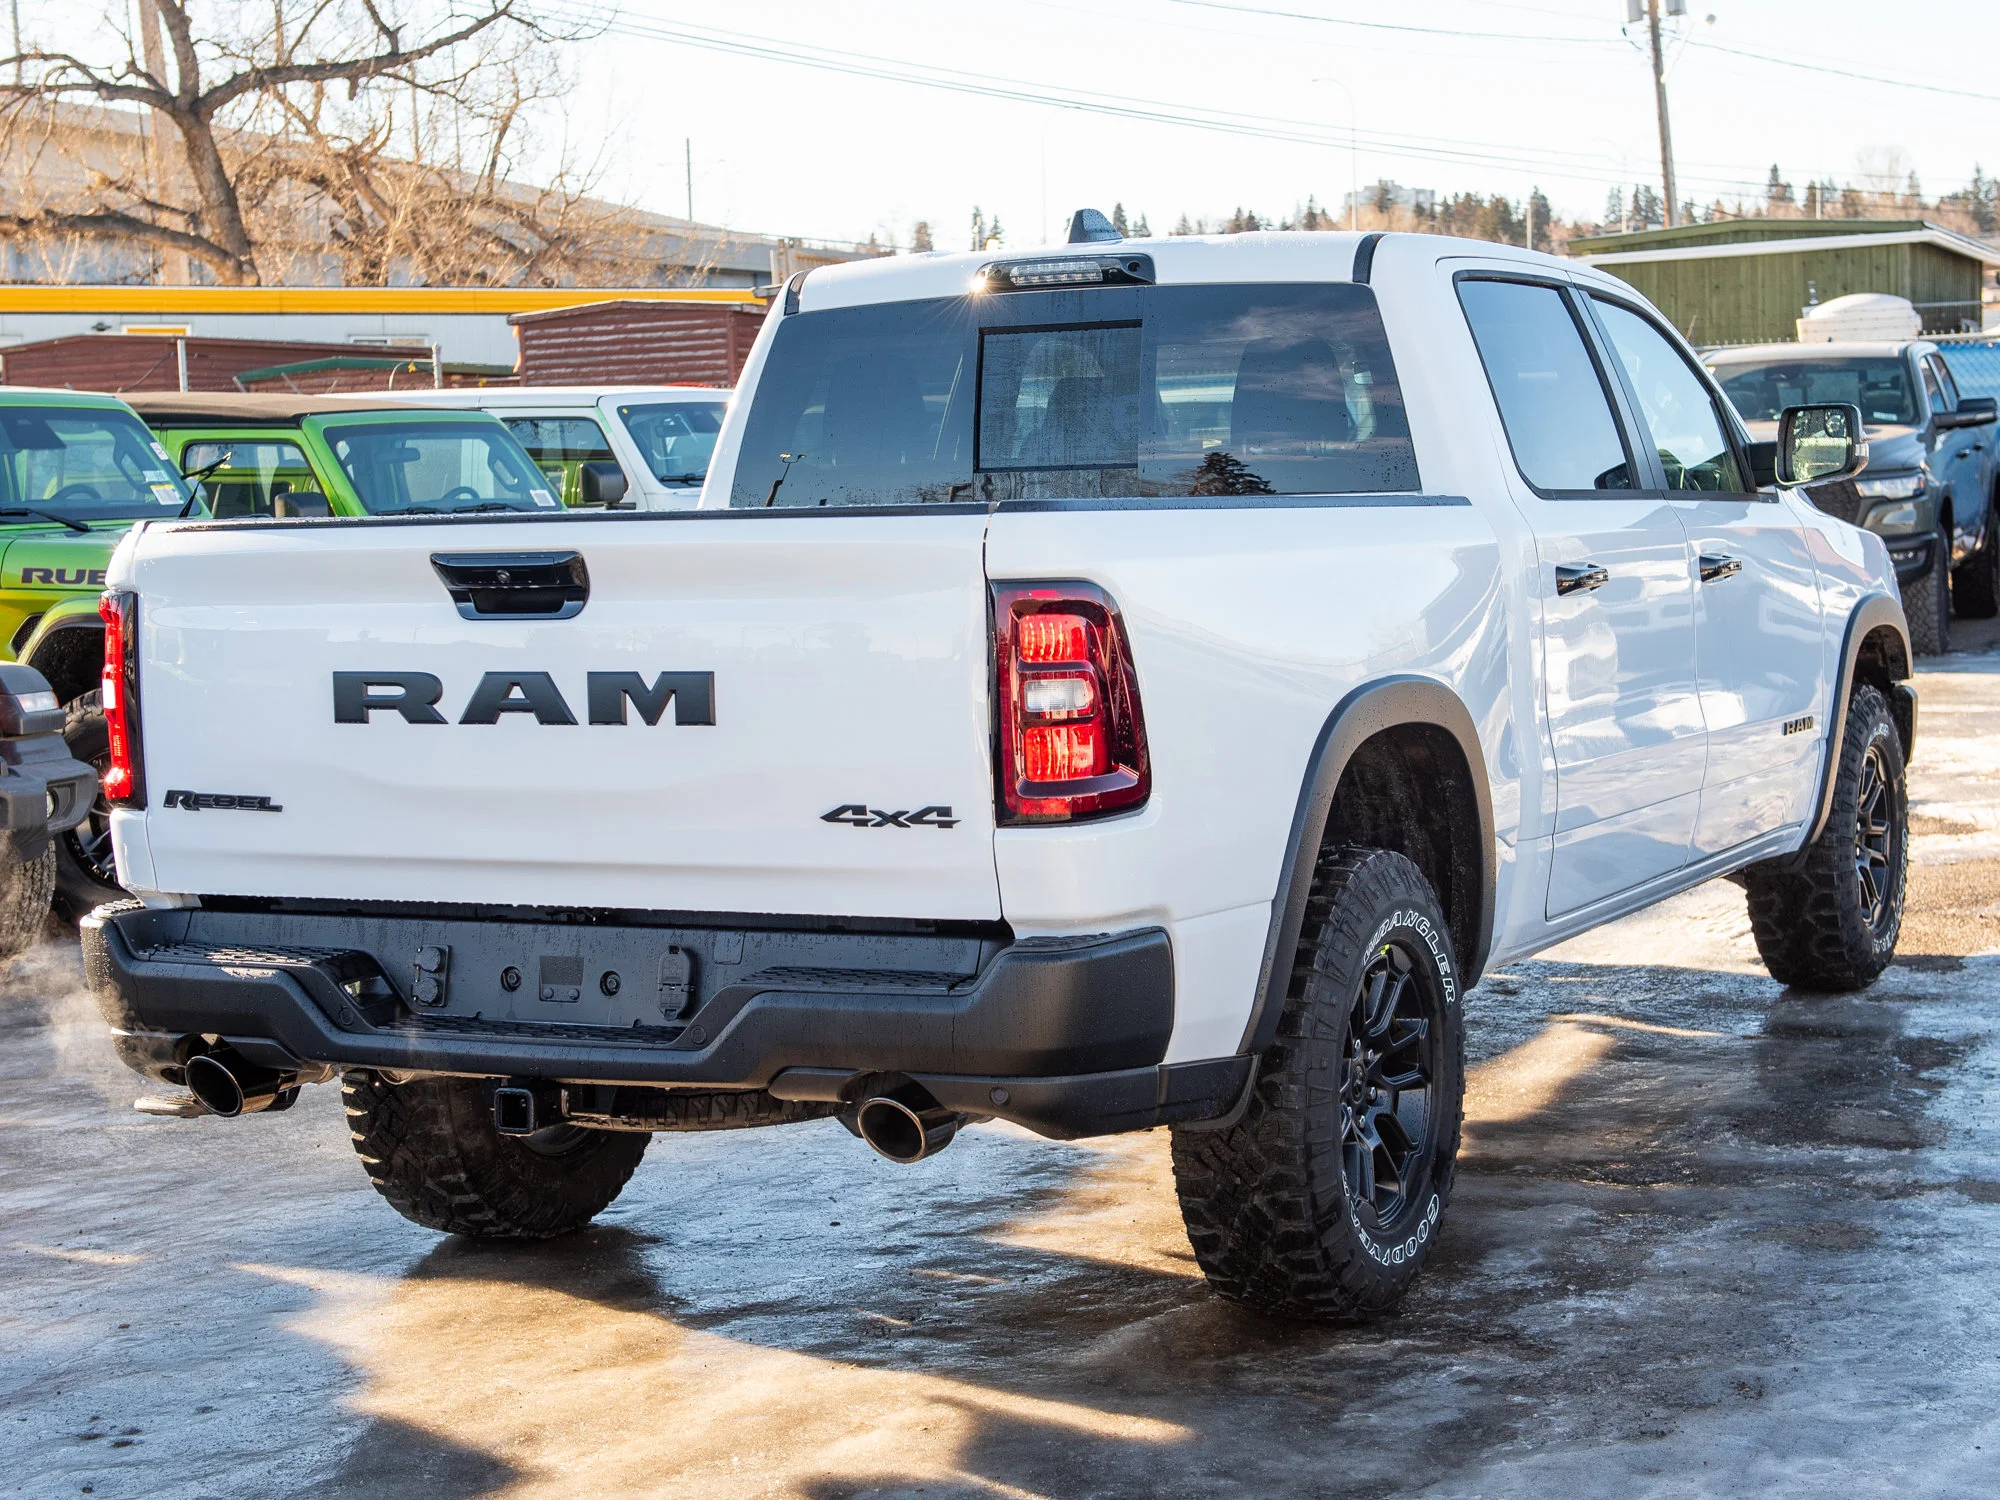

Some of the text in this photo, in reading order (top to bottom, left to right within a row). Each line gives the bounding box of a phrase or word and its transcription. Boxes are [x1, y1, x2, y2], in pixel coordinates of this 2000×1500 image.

[333, 671, 716, 726] RAM
[1782, 715, 1814, 736] RAM
[163, 790, 283, 812] REBEL
[819, 804, 962, 829] 4x4
[1363, 910, 1456, 1003] WRANGLER
